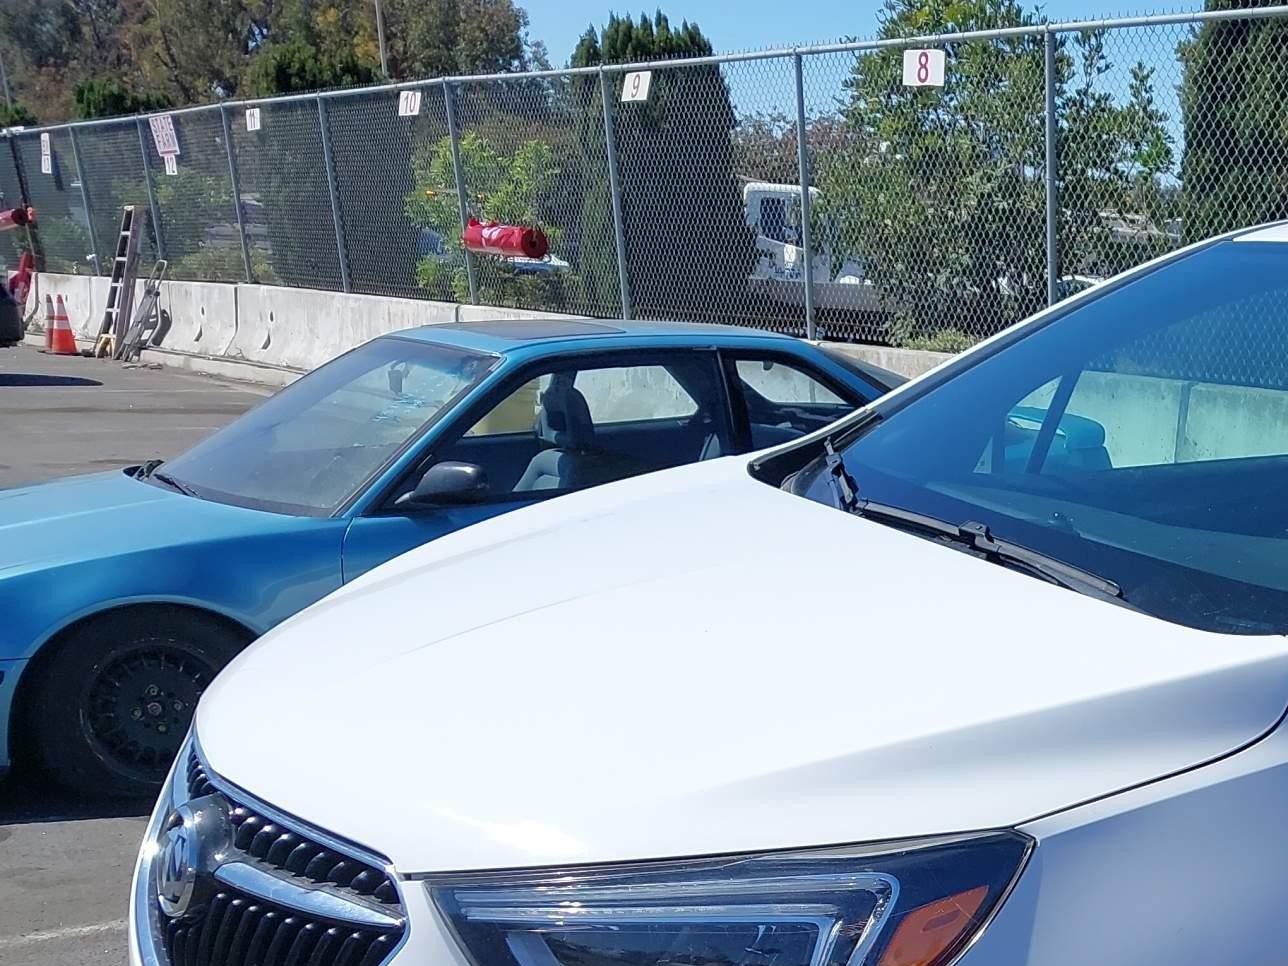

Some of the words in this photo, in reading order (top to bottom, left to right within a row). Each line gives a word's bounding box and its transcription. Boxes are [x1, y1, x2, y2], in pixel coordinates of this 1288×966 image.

[918, 52, 928, 83] 8
[631, 73, 640, 98] 9
[404, 92, 416, 113] 10
[249, 109, 256, 129] 11
[166, 157, 176, 174] 12
